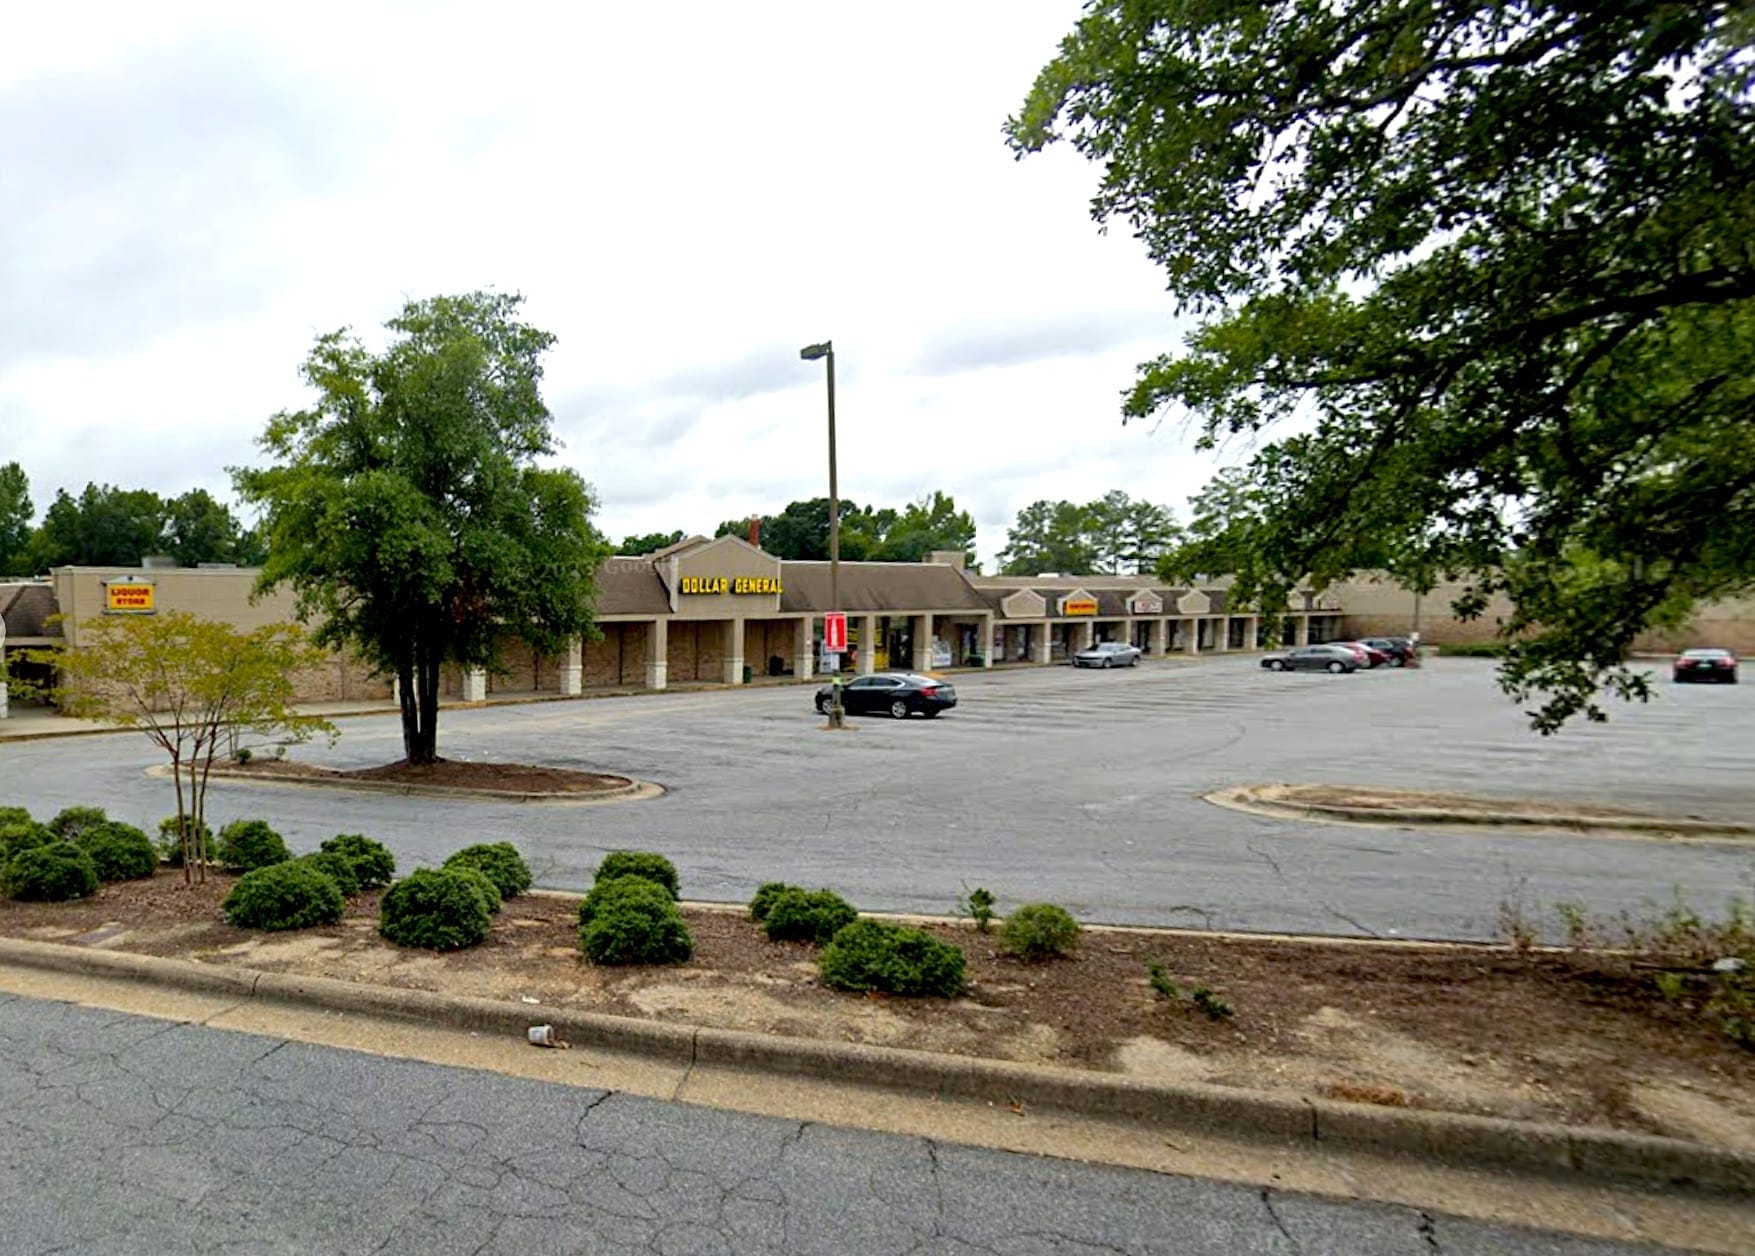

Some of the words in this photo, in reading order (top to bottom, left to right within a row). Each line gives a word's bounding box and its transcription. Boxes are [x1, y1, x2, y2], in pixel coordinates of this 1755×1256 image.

[681, 577, 728, 593] DOLLAR
[733, 577, 783, 593] GENERAL
[111, 588, 149, 597] LIQUOR
